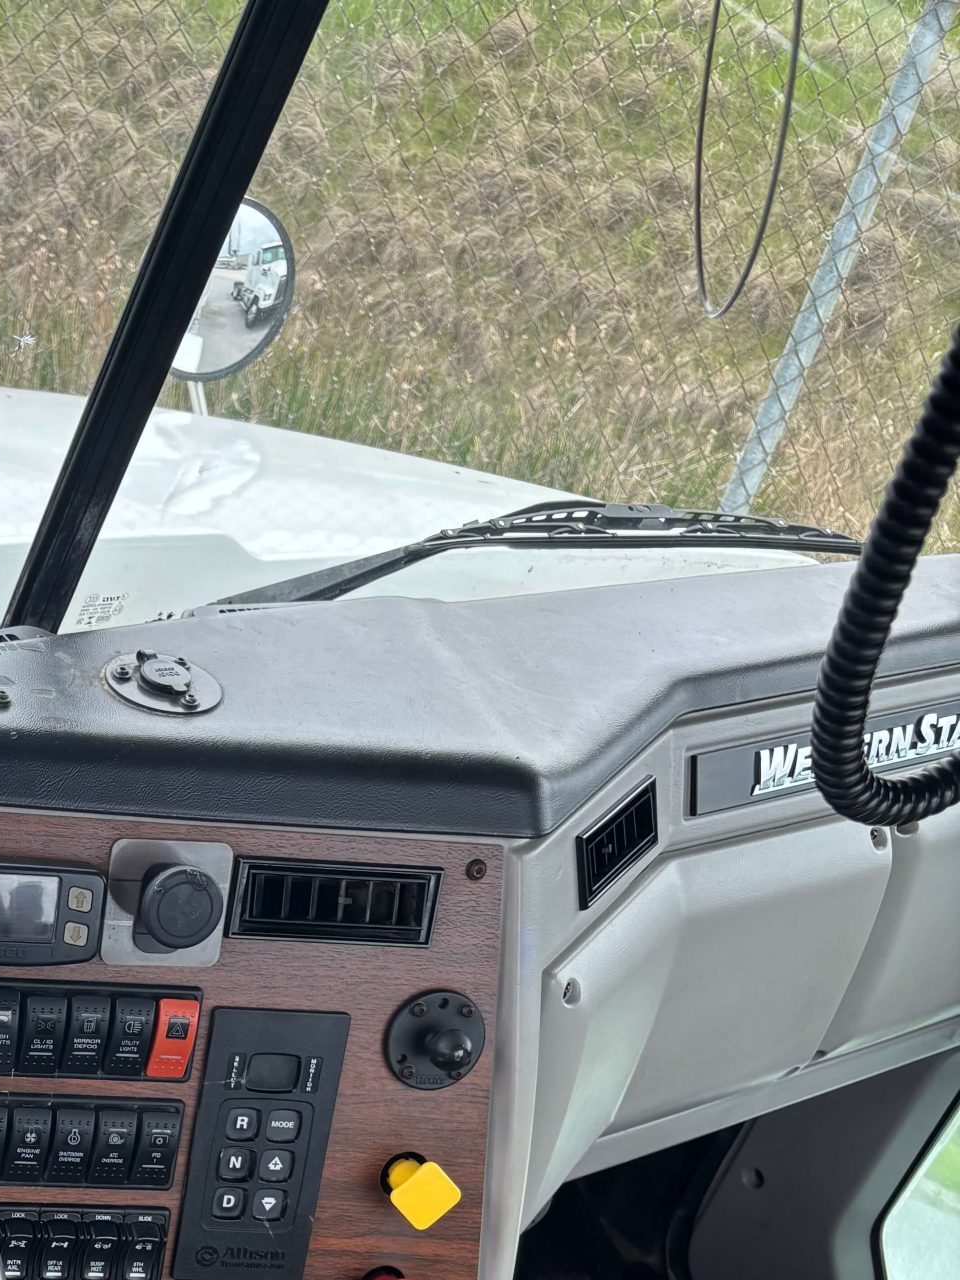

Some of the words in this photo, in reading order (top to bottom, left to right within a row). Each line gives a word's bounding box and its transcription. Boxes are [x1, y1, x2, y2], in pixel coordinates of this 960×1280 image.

[759, 723, 915, 790] WERN
[305, 1058, 317, 1092] MONITOR
[236, 1116, 248, 1129] R
[271, 1121, 294, 1129] MODE
[229, 1156, 242, 1168] N
[222, 1195, 235, 1208] D
[222, 1246, 286, 1261] Allison
